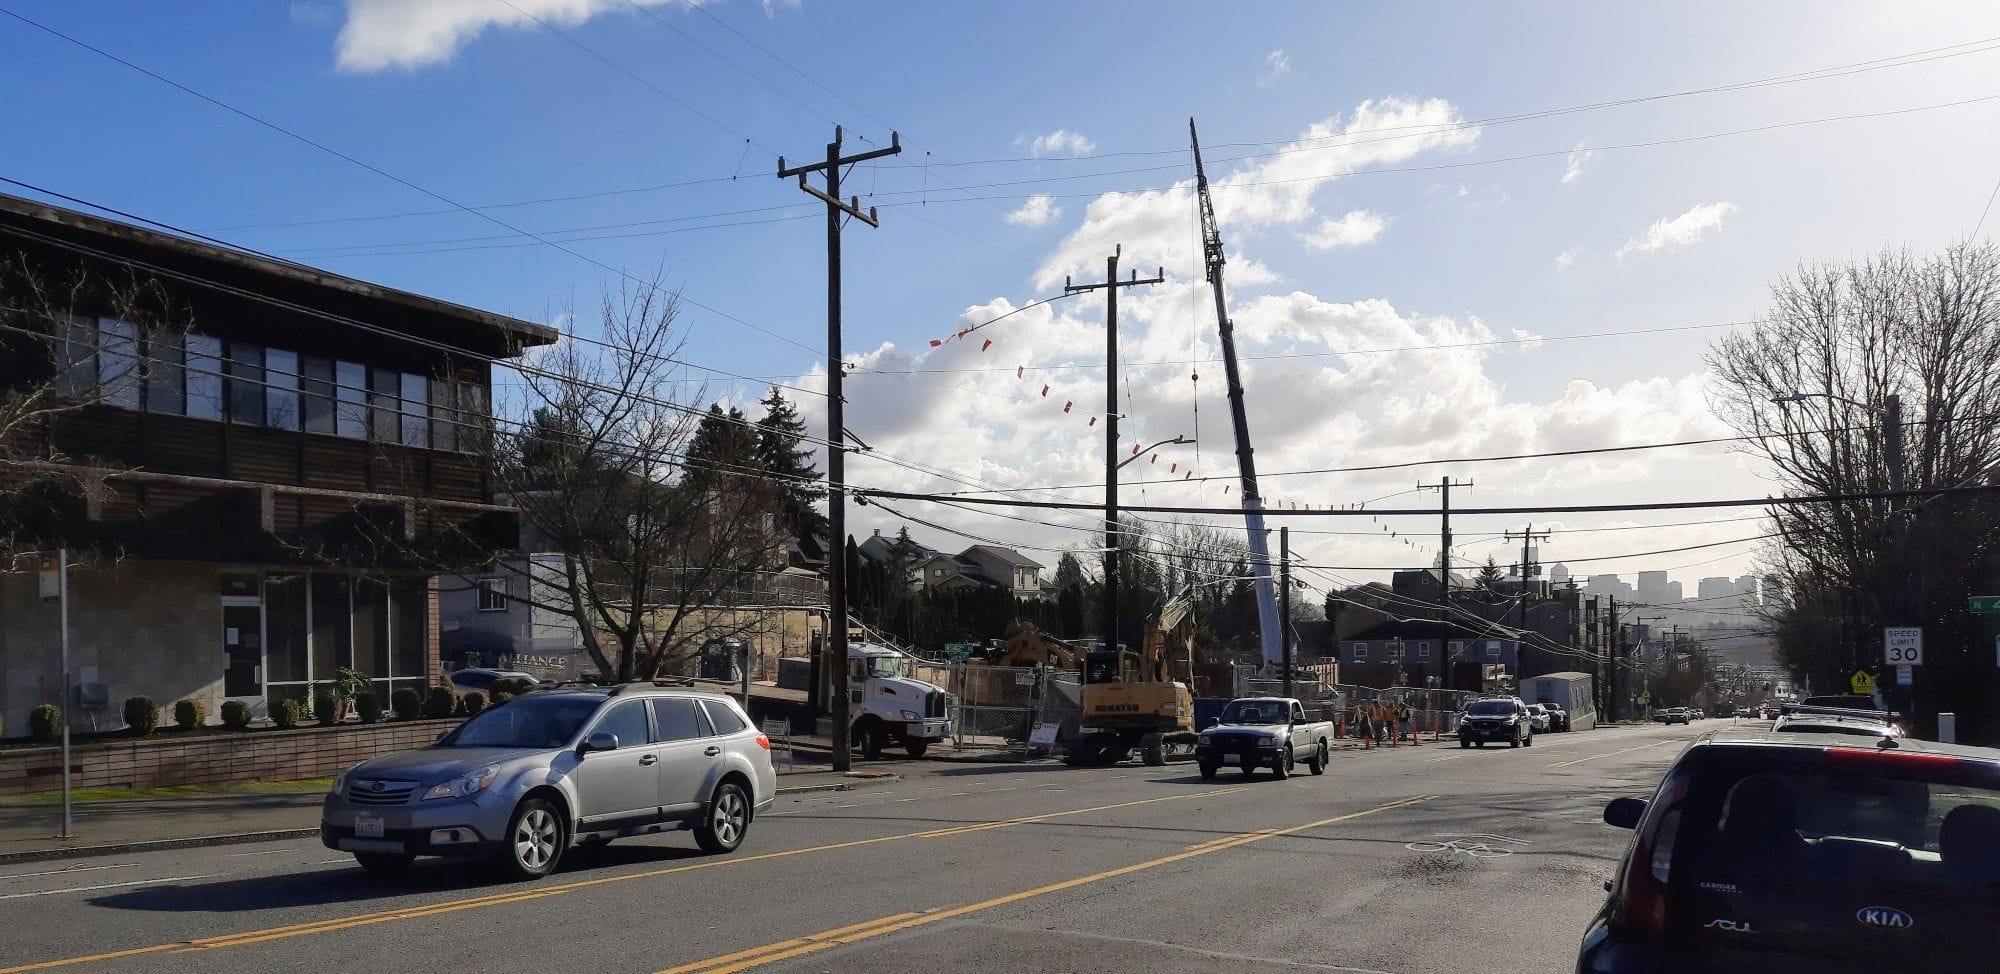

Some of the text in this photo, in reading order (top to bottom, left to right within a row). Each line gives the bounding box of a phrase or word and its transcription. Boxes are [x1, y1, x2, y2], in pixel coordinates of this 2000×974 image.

[1890, 648, 1918, 661] 30
[1095, 703, 1140, 712] KOMATSU
[1866, 910, 1904, 927] KIA
